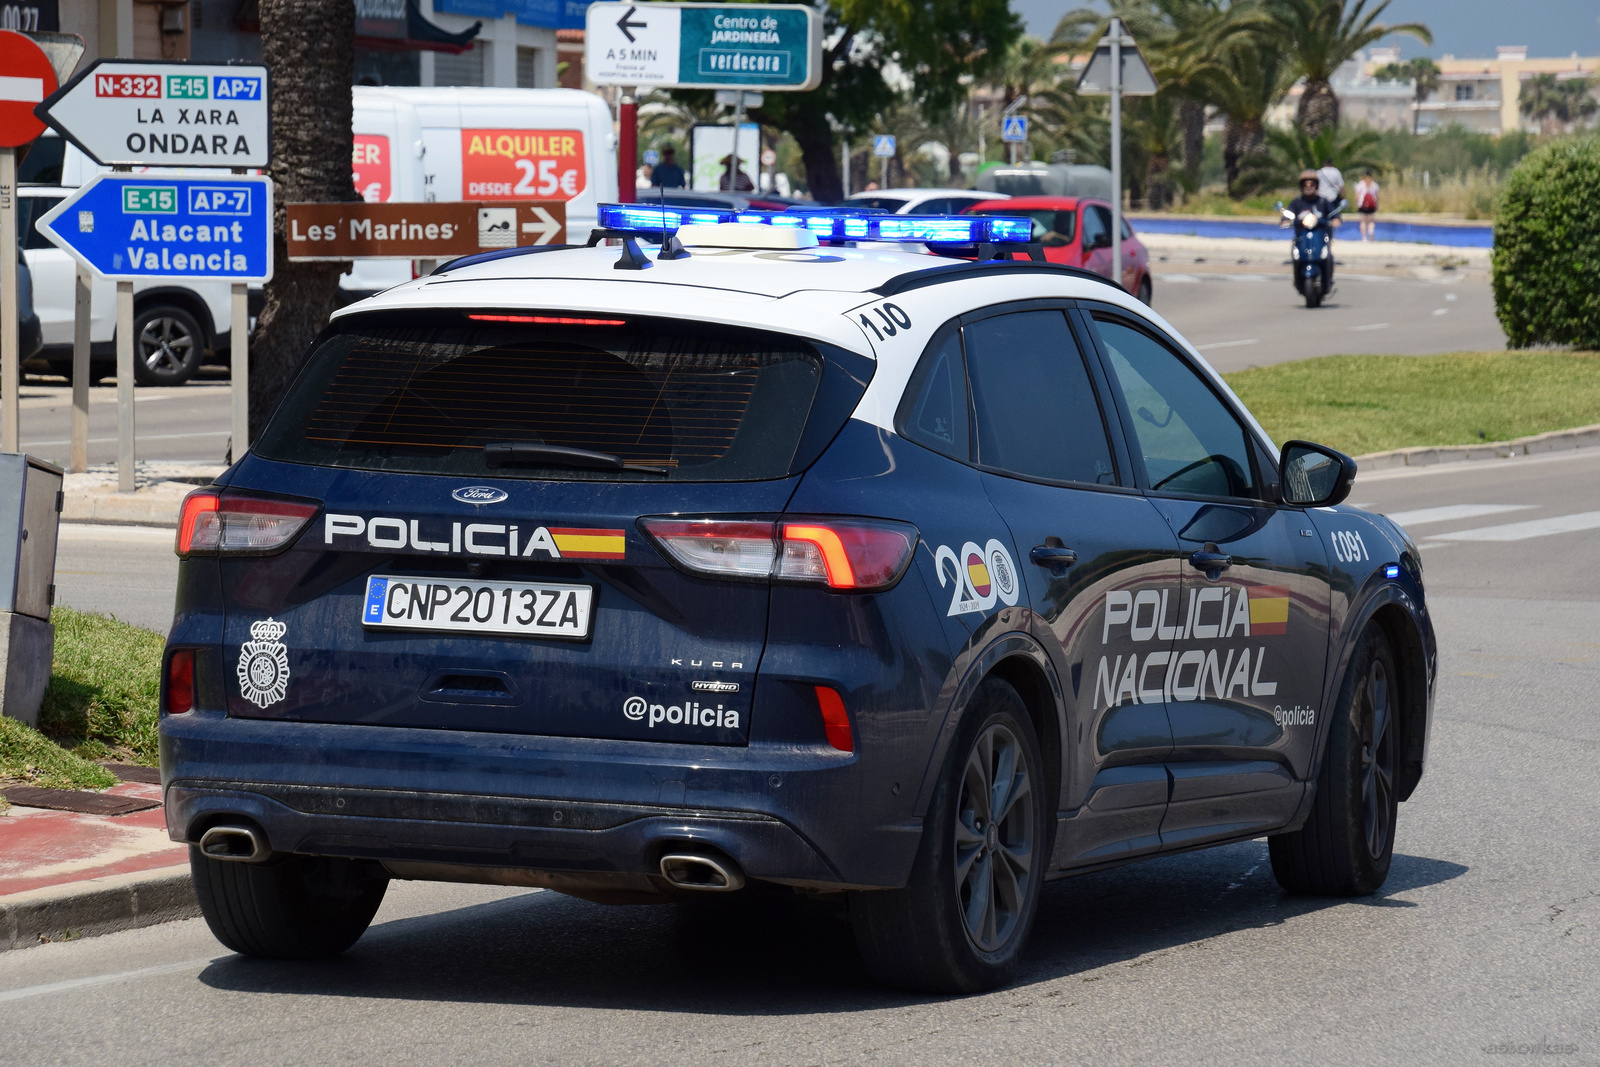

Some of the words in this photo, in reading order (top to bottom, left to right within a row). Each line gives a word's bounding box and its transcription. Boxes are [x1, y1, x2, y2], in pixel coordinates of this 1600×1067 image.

[714, 14, 759, 29] Centro
[760, 15, 778, 30] de
[710, 30, 780, 44] JARDINERÍA
[606, 48, 616, 60] A
[619, 48, 627, 60] 5
[630, 49, 657, 61] MIN
[710, 52, 780, 72] verdecora
[98, 77, 158, 96] N-332
[169, 78, 205, 97] E-15
[216, 79, 259, 98] AP-7
[137, 108, 164, 124] LA
[178, 108, 239, 125] XARA
[126, 132, 251, 155] ONDARA
[468, 135, 577, 159] ALQUILER
[469, 182, 512, 196] DESDE
[513, 159, 578, 196] 25€
[127, 191, 172, 209] E-15
[194, 192, 246, 210] AP-7
[130, 219, 243, 243] Alacant
[291, 219, 337, 241] Les
[350, 218, 454, 241] Marines
[127, 247, 248, 271] Valencia
[463, 488, 496, 499] Ford
[325, 513, 561, 558] POLICÍA
[935, 538, 1019, 617] 200
[371, 604, 380, 615] E
[386, 582, 579, 629] CNP2013ZA
[1102, 586, 1251, 644] POLICÍA
[671, 658, 743, 669] KUGA
[694, 682, 737, 691] HYBRID
[1093, 646, 1278, 710] NACIONAL
[623, 696, 740, 729] @policia
[1273, 704, 1315, 730] @policia
